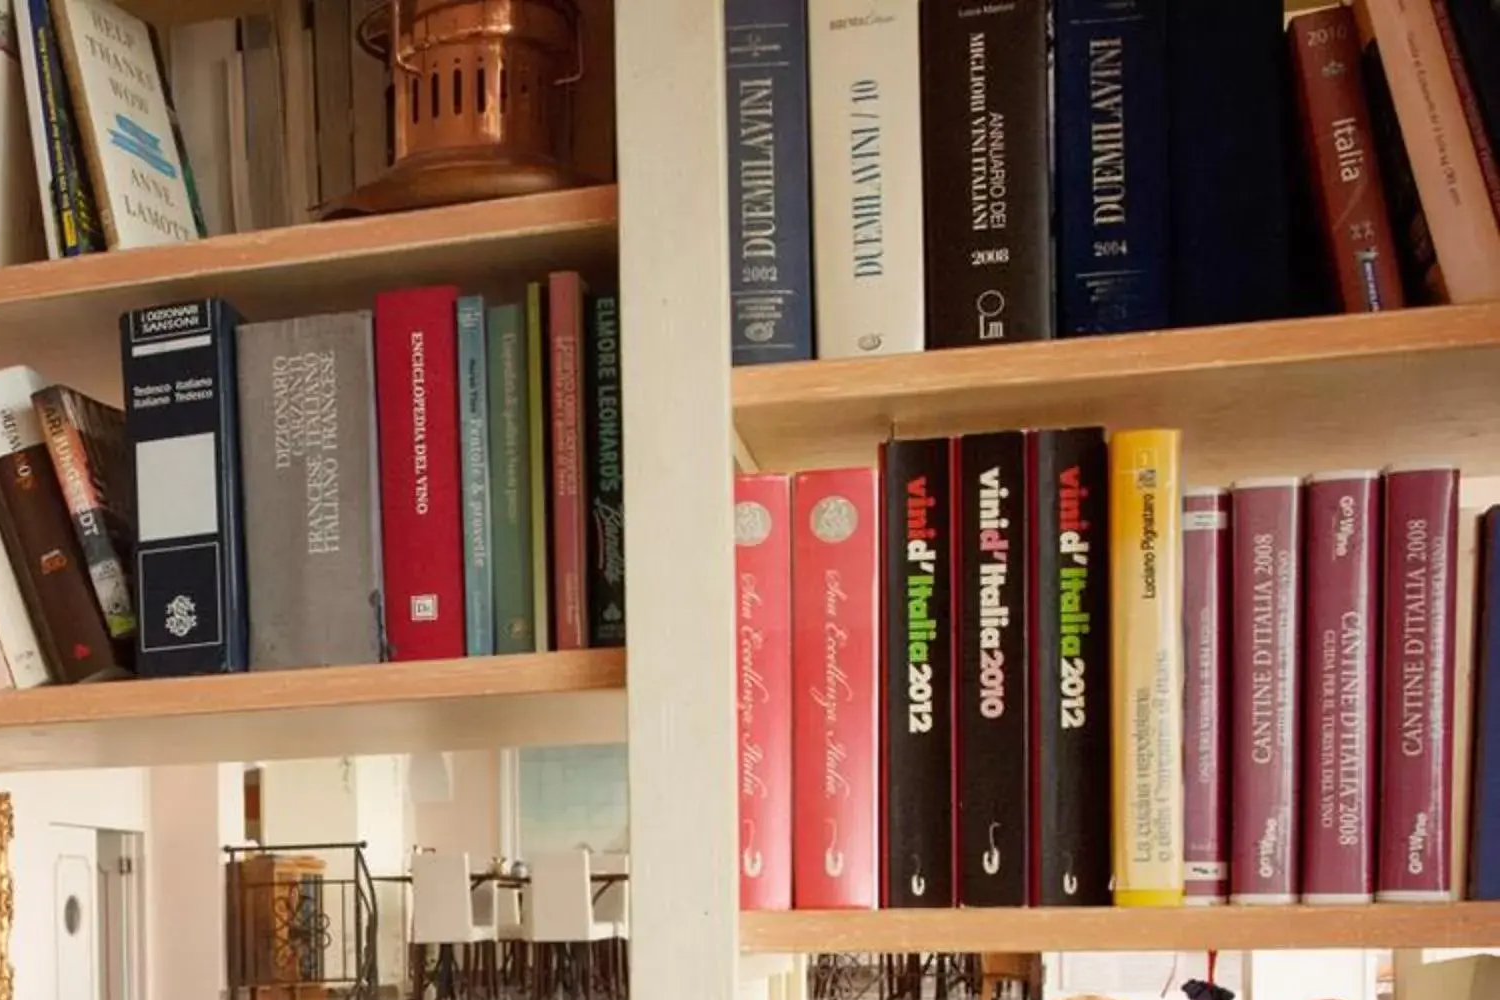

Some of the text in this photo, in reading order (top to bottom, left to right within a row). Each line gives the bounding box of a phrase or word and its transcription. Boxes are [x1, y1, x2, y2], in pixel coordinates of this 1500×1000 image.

[85, 34, 156, 93] THANKS
[109, 77, 151, 114] WOW
[851, 79, 880, 104] 10
[969, 32, 990, 232] MIGLIORI VINI ITALIANI
[1088, 36, 1127, 226] DUEMILAVINI
[1331, 117, 1365, 184] Italia
[130, 168, 176, 209] ANNE
[740, 76, 777, 259] DUEMILAVINI
[988, 110, 1007, 230] ANNUARIO DEI
[123, 194, 190, 242] LAMOTT
[851, 126, 884, 279] DUEMILAVINI
[742, 266, 779, 283] 2002
[970, 247, 1010, 266] 2008
[1093, 239, 1129, 258] 2004
[141, 315, 201, 334] SANSONI
[133, 383, 172, 397] Tedesco
[174, 388, 214, 403] Tedesco
[272, 354, 291, 469] DIZIONARIO
[302, 351, 320, 452] ITALIANO
[410, 329, 429, 516] ENCICLOPEDIA DEL VINO
[596, 296, 620, 492] ELMORE LEONARD'S
[319, 349, 342, 553] ITALIANO FRANCESE
[473, 416, 486, 478] Pentole
[1140, 493, 1157, 600] Luciano Pignataro
[1252, 532, 1274, 766] CANTINE D'ITALIA 2008
[1321, 629, 1336, 671] GUIDA
[1401, 519, 1428, 758] CANTINE D'ITALIA 2008
[908, 662, 934, 734] 2012
[979, 649, 1006, 719] 2010
[1059, 656, 1087, 729] 2012
[1321, 673, 1336, 698] PER
[1320, 715, 1335, 767] TURISTA
[1338, 611, 1362, 847] CANTINE D'ITALIA 2008
[1319, 794, 1335, 828] VINO
[1320, 768, 1335, 794] DEL
